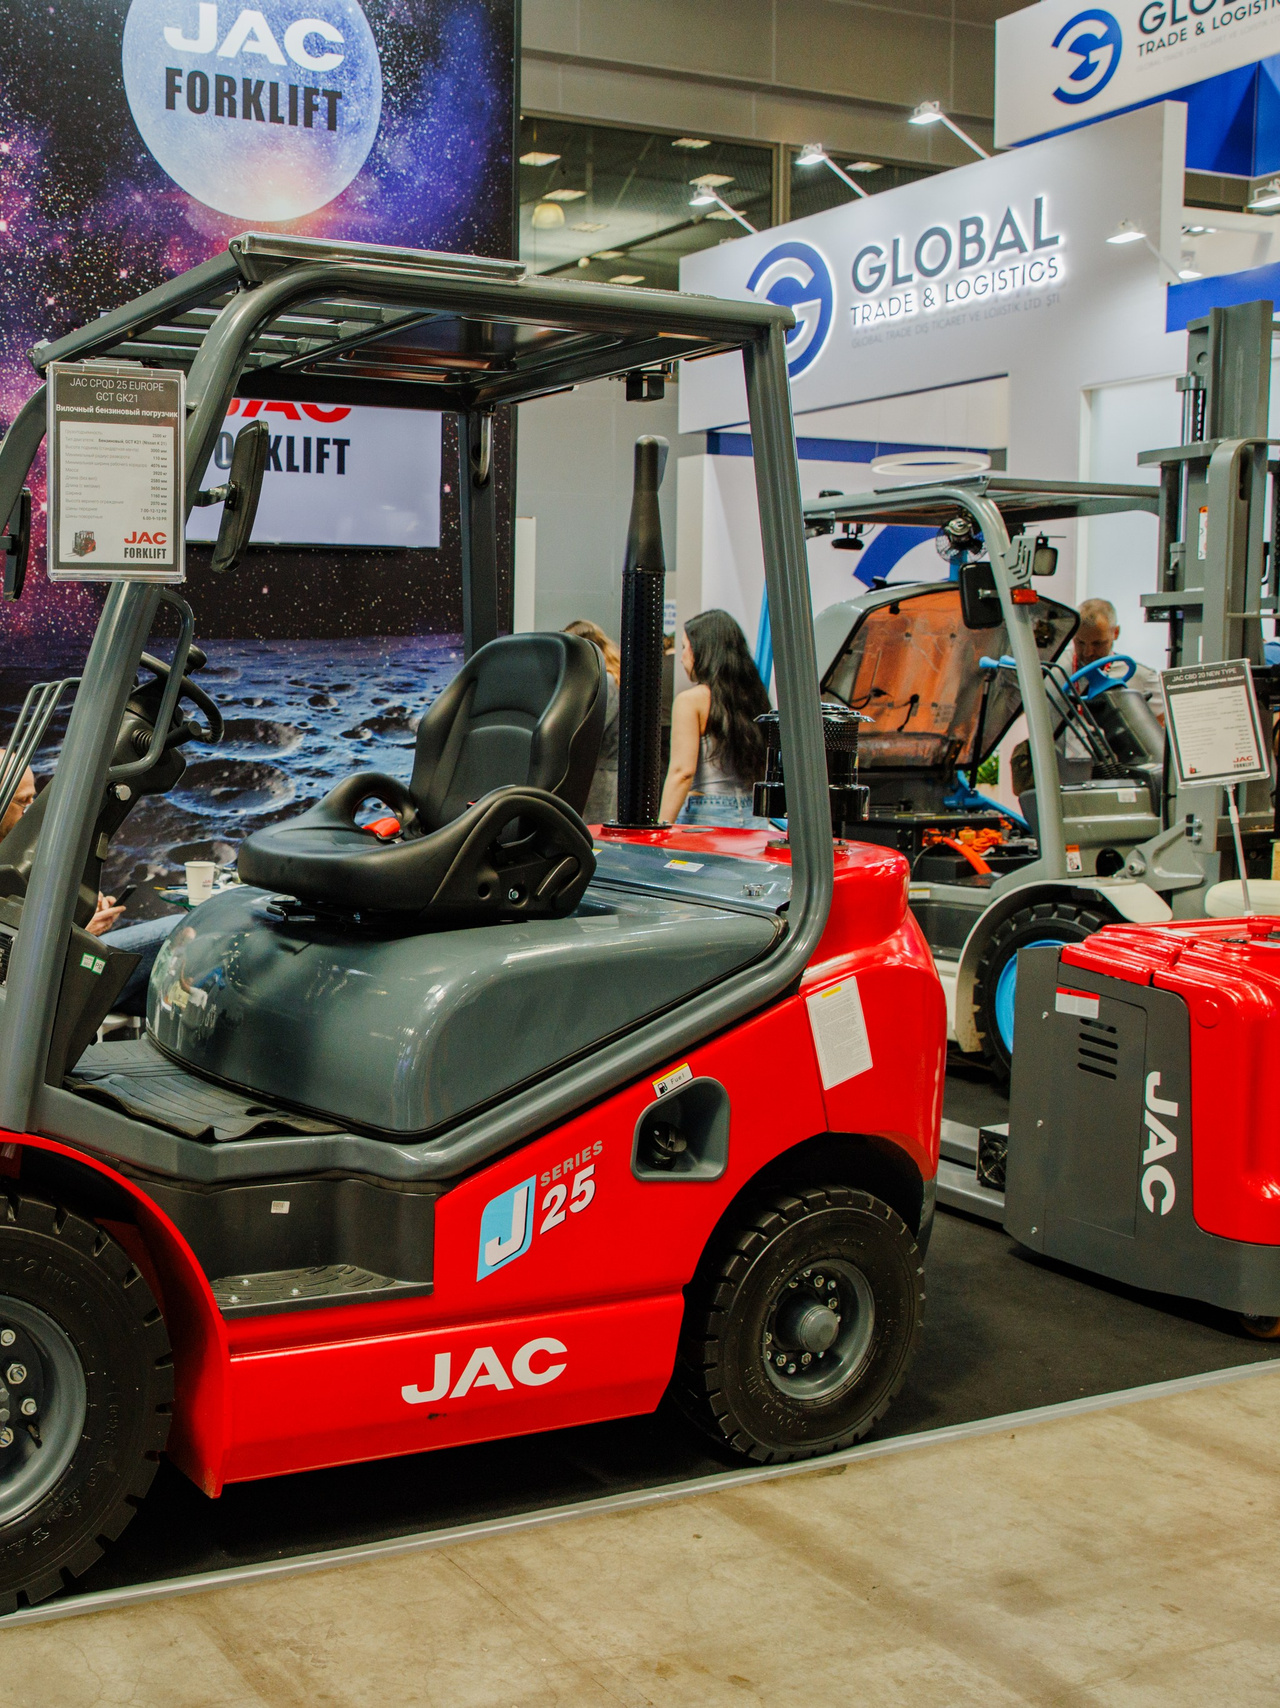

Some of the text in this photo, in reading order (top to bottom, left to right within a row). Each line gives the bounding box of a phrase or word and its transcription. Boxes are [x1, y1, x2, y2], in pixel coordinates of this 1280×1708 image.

[164, 2, 345, 71] JAC
[1137, 28, 1188, 56] TRADE
[1195, 22, 1205, 36] &
[164, 68, 342, 131] FORKLIFT
[852, 197, 1059, 294] GLOBAL
[850, 257, 1058, 325] TRADE & LOGISTICS
[70, 378, 164, 391] JAC CPQD 25 EUROPE
[96, 393, 138, 402] GCT GK21
[56, 404, 178, 418] Вилочный бензиновый погрузчик
[214, 432, 350, 475] OKLIFT
[124, 532, 167, 545] JAC
[124, 548, 166, 559] FORKLIFT
[670, 1073, 684, 1084] Fuel
[540, 1140, 603, 1188] SERIES
[1141, 1071, 1178, 1216] JAC
[484, 1164, 596, 1267] J 25
[402, 1337, 568, 1404] JAC
